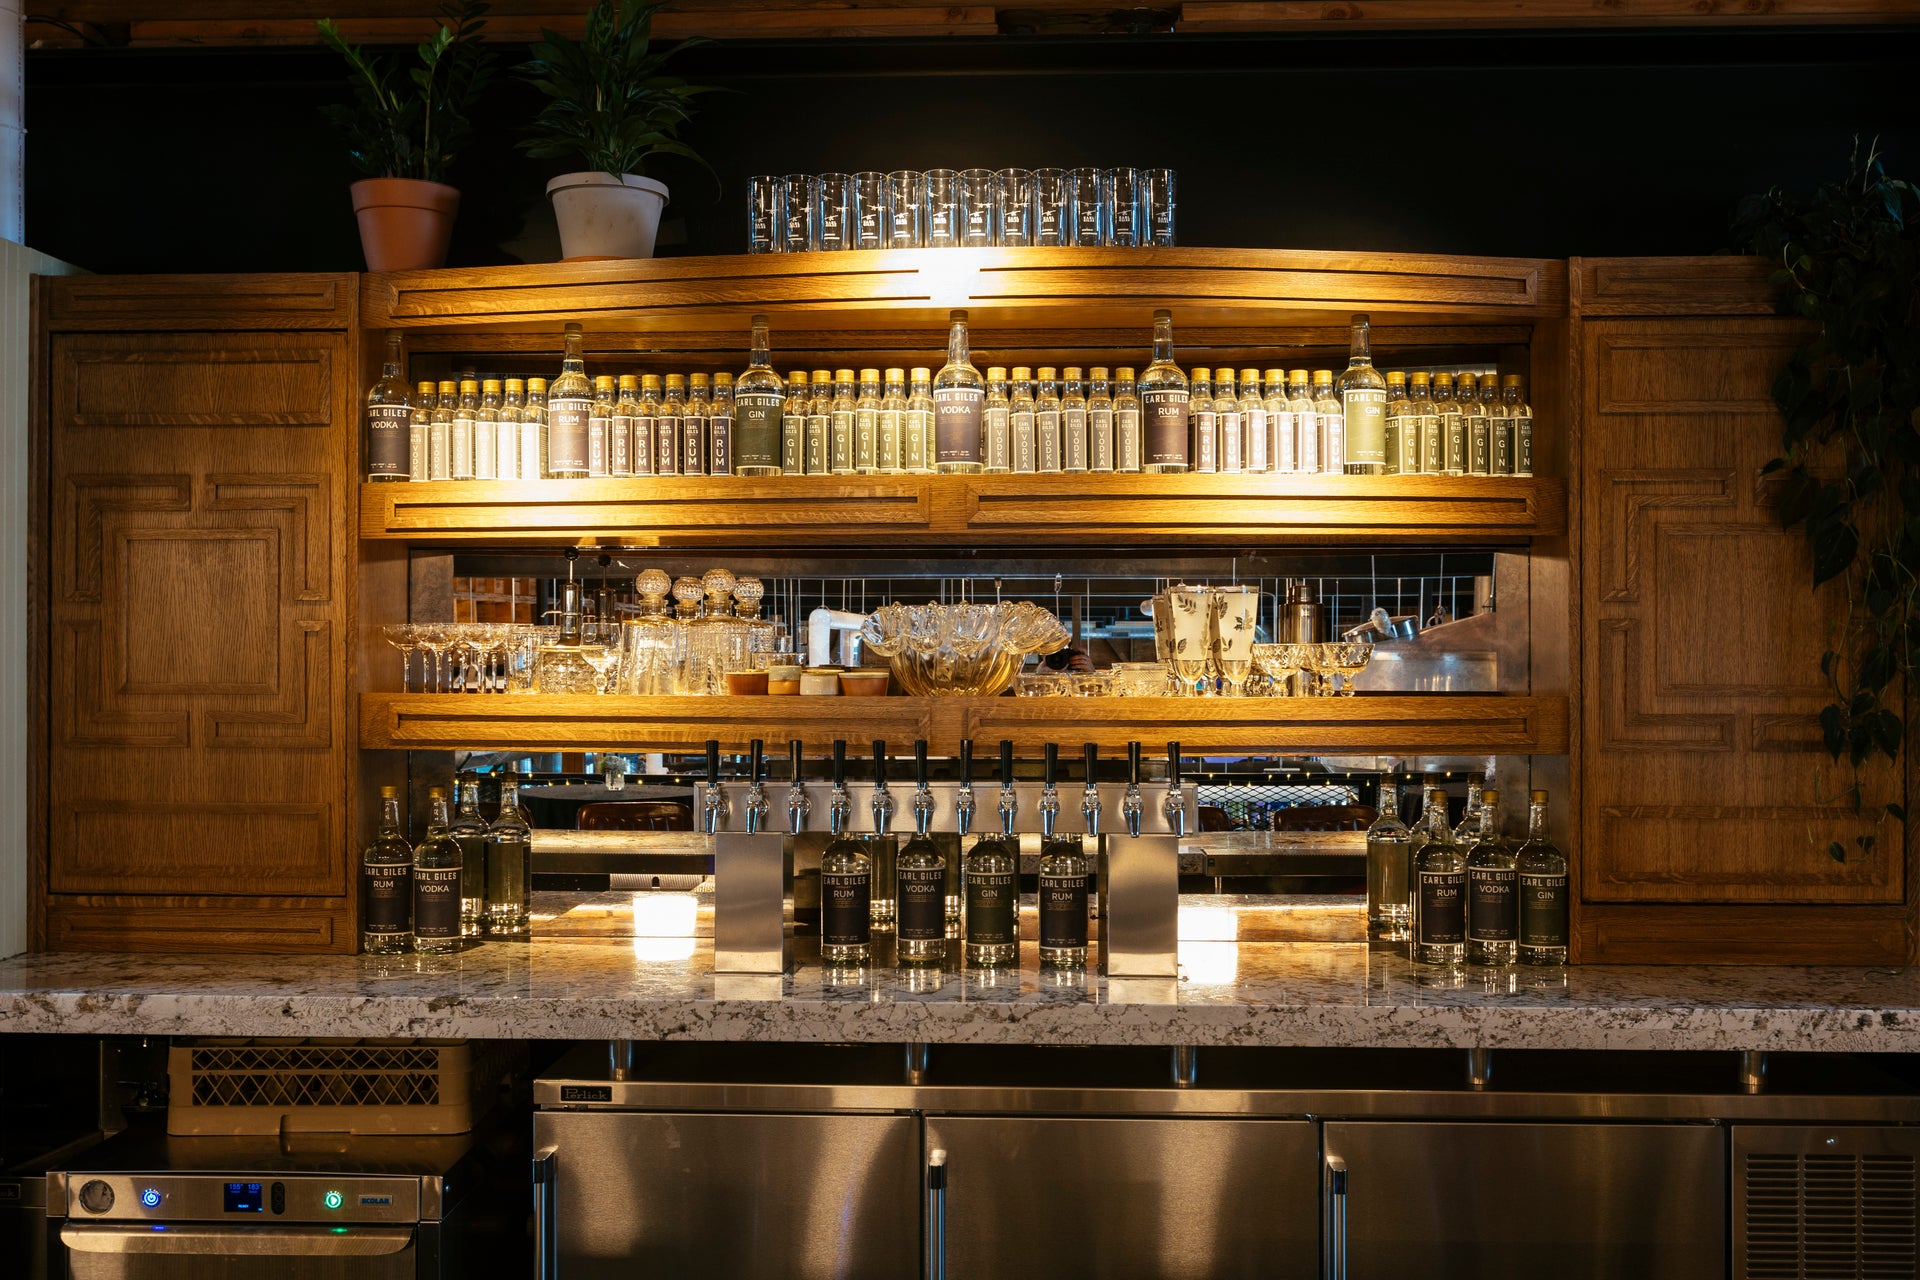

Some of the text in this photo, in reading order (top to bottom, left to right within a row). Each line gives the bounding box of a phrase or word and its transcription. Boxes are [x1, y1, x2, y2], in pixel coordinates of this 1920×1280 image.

[1146, 395, 1188, 403] EARL GILES
[1349, 394, 1370, 402] EARL
[383, 409, 406, 418] GILES
[593, 441, 601, 467] RUM
[617, 439, 625, 465] RUM
[716, 439, 724, 465] RUM
[434, 872, 456, 880] GILES
[1424, 876, 1444, 884] EARL
[1496, 873, 1515, 881] GILES
[844, 877, 865, 885] GILES
[1042, 879, 1058, 887] EARL
[1523, 878, 1542, 886] EARL
[564, 1088, 607, 1099] Perlick
